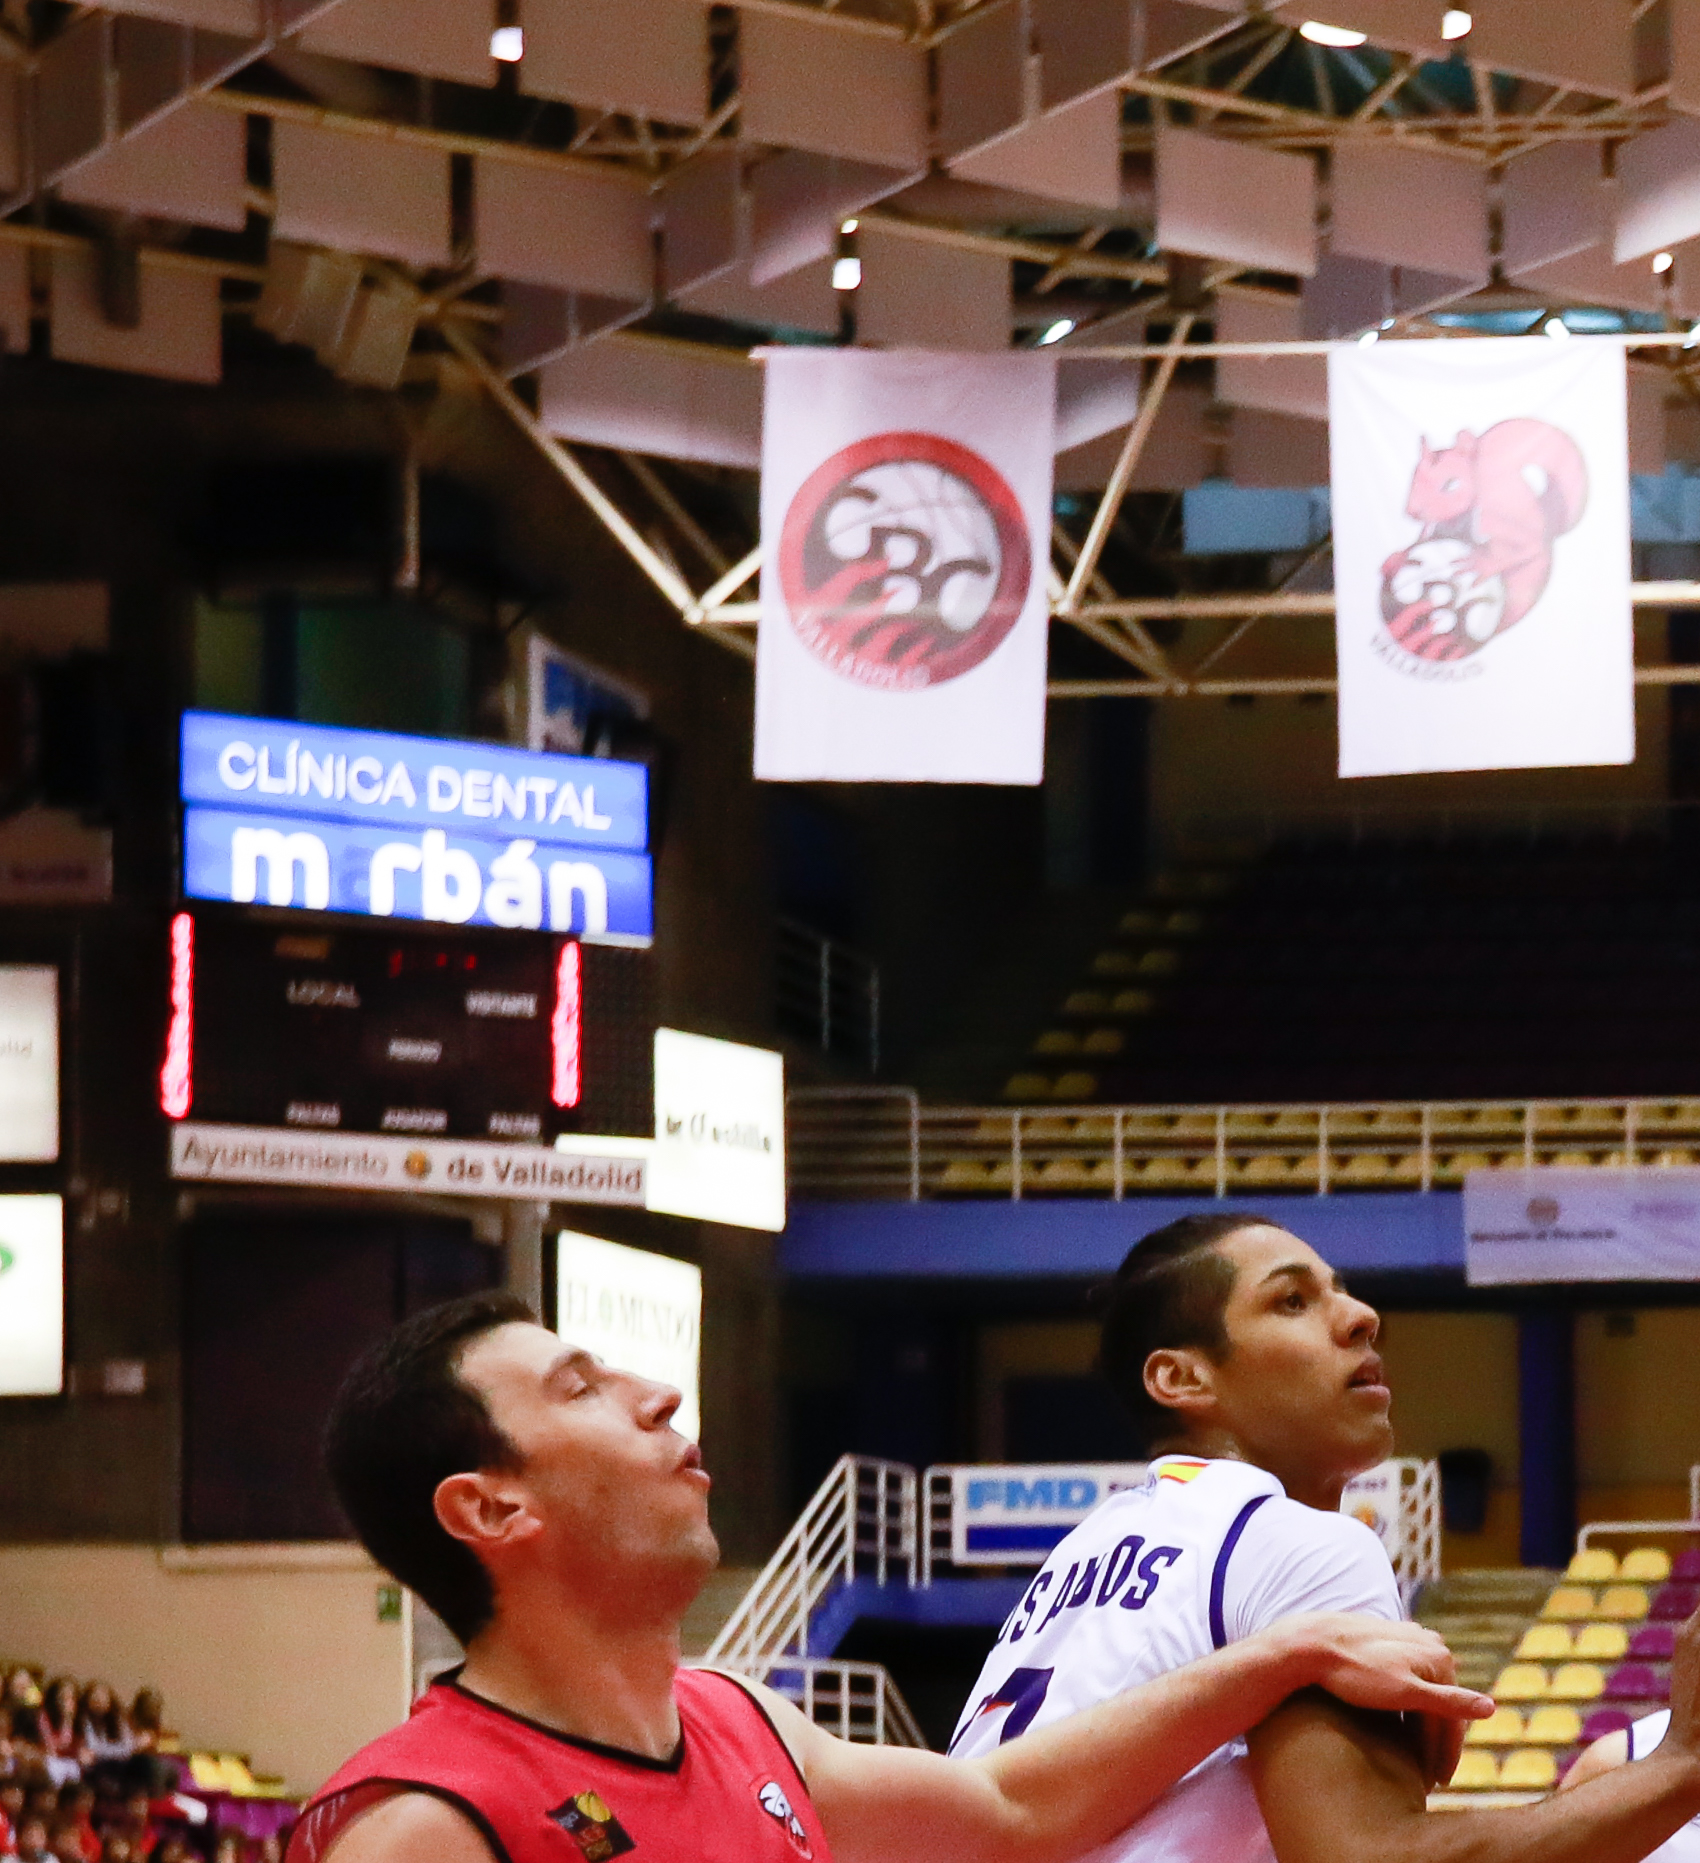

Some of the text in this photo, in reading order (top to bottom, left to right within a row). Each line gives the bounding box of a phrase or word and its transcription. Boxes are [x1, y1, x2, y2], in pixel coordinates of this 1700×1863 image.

[218, 739, 612, 831] CLÍNICA DENTAL
[180, 1135, 643, 1193] Ayuntamiento de Valladolid
[967, 1479, 1098, 1511] FMD
